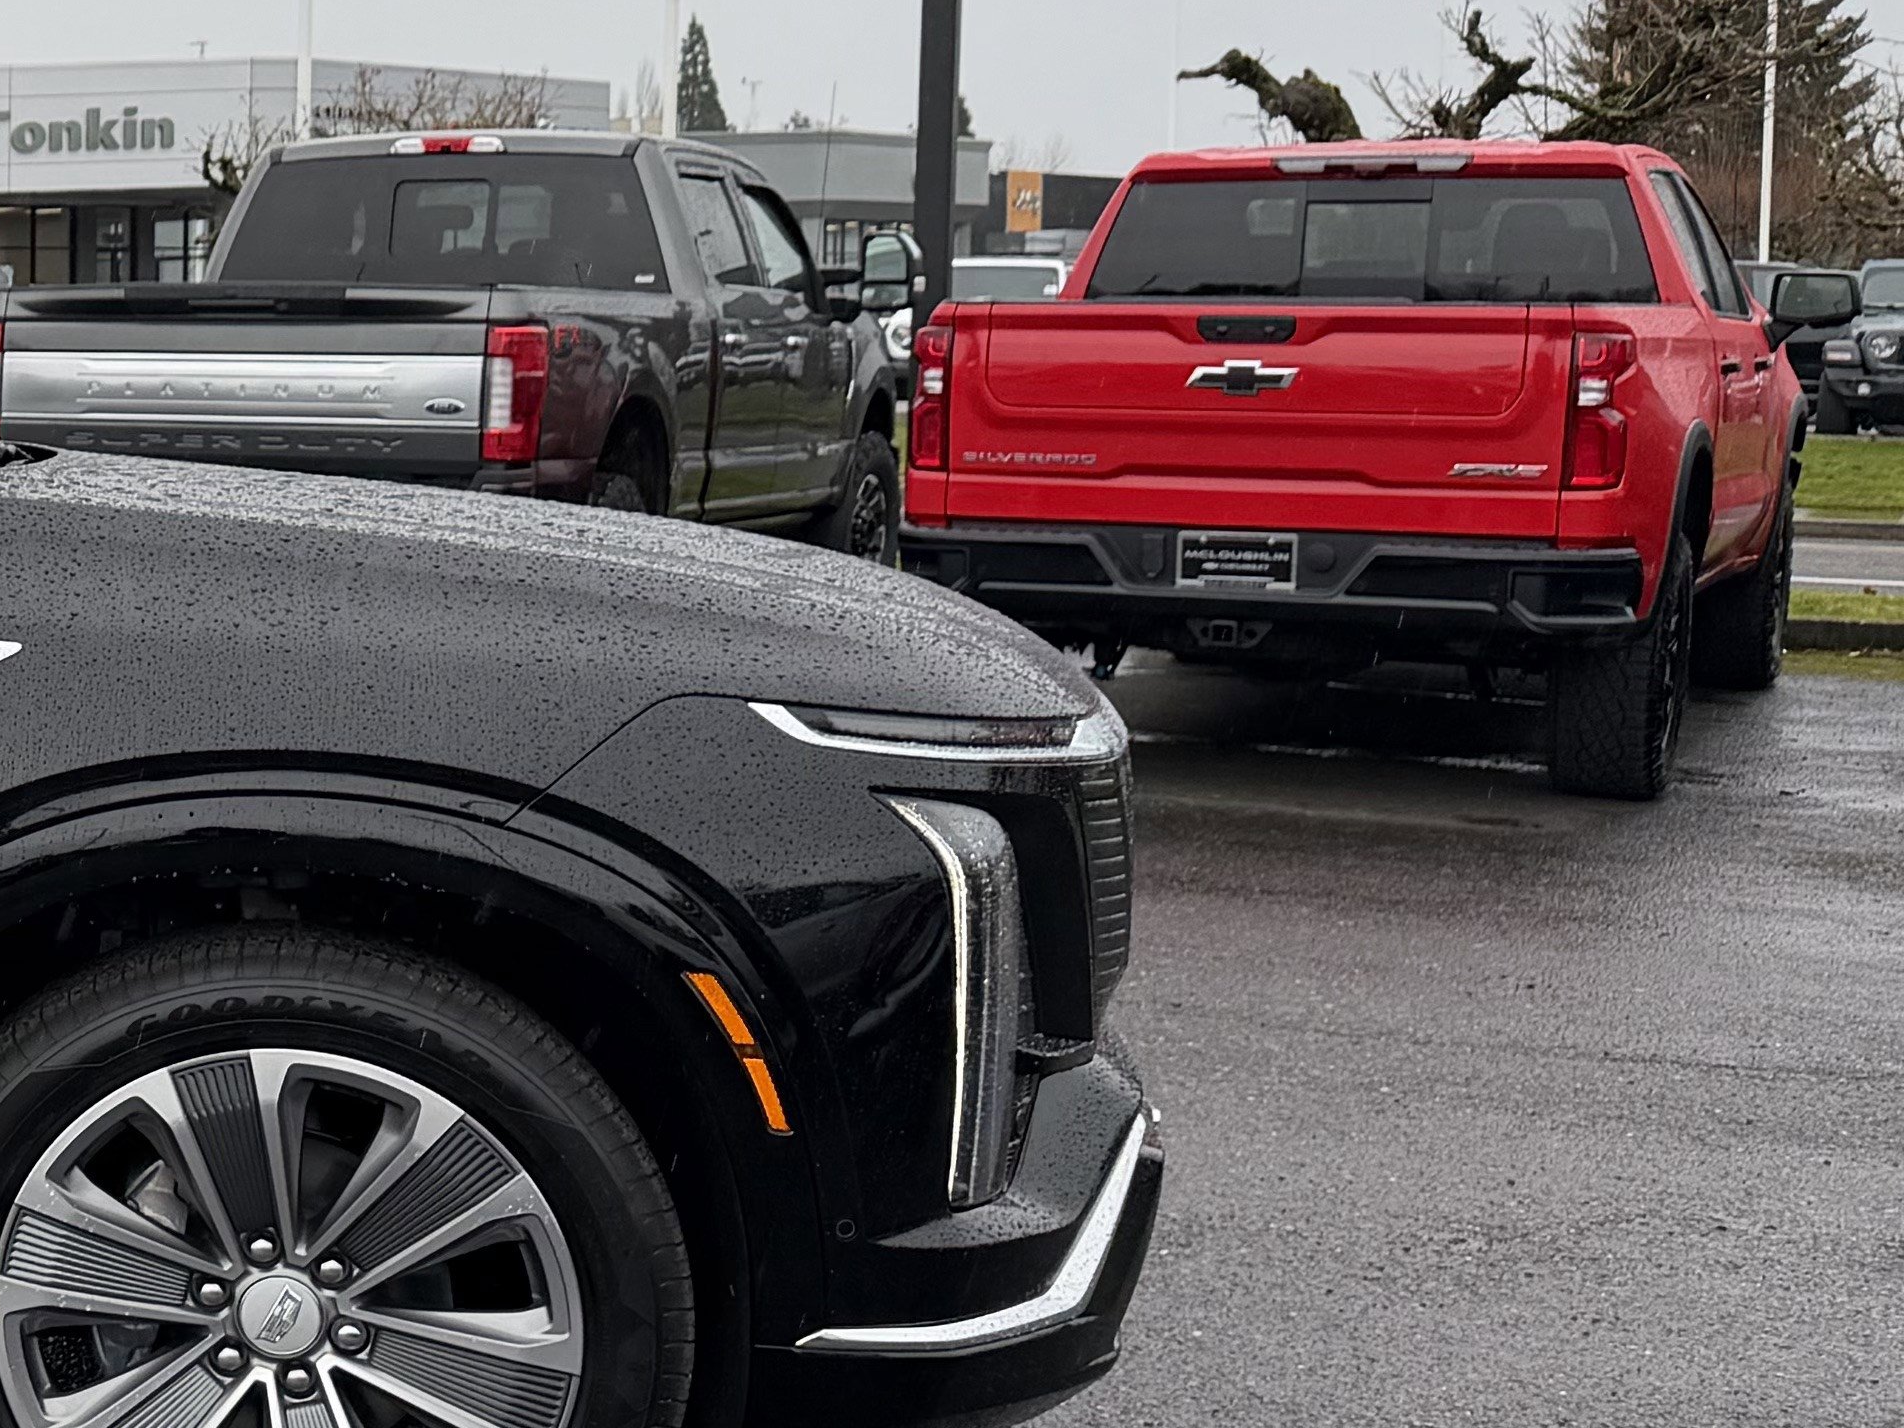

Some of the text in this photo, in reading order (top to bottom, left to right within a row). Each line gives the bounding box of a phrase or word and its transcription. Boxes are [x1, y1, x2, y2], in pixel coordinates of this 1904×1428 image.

[87, 381, 383, 400] PLATINUM
[962, 450, 1097, 465] SILVERADO
[124, 993, 498, 1078] GOODYEAR
